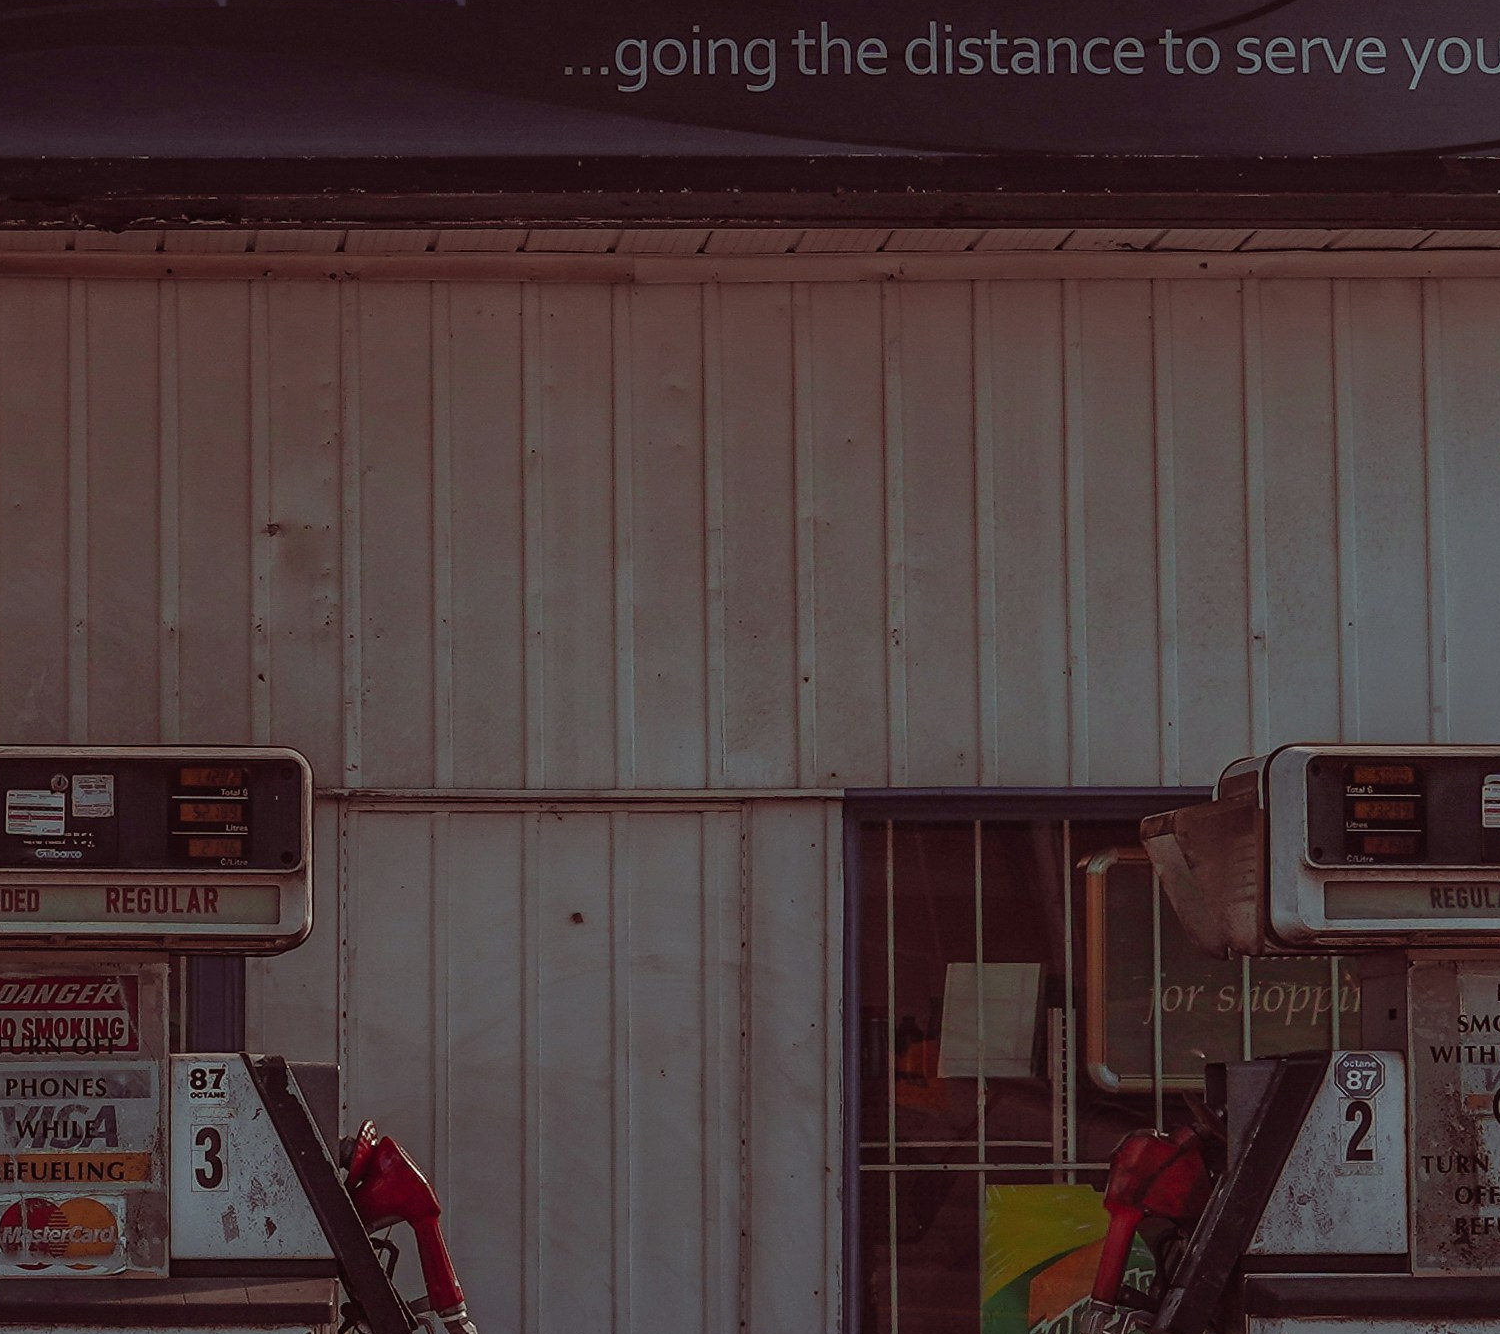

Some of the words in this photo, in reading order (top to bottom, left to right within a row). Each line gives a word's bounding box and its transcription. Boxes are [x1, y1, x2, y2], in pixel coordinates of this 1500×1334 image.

[791, 20, 888, 76] the
[904, 20, 1146, 76] distance
[1158, 28, 1216, 76] to
[1234, 39, 1388, 77] serve
[220, 788, 241, 796] Total
[1346, 785, 1366, 794] Total
[225, 823, 249, 832] Litres
[1345, 821, 1369, 829] Litres
[34, 848, 83, 859] Gilbarco
[105, 886, 220, 914] REGULAR
[21, 1017, 125, 1040] SMOKING
[71, 1037, 118, 1055] OFF
[1342, 1059, 1377, 1068] octane
[5, 1078, 107, 1097] PHONES
[189, 1068, 226, 1091] 87
[1346, 1069, 1378, 1090] 87
[189, 1091, 226, 1099] OCTANE
[16, 1120, 96, 1139] WHILE
[1345, 1100, 1374, 1162] 2
[194, 1126, 223, 1189] 3
[1421, 1154, 1489, 1174] TURN
[1454, 1185, 1500, 1205] OFF
[1, 1225, 117, 1244] MasterCard
